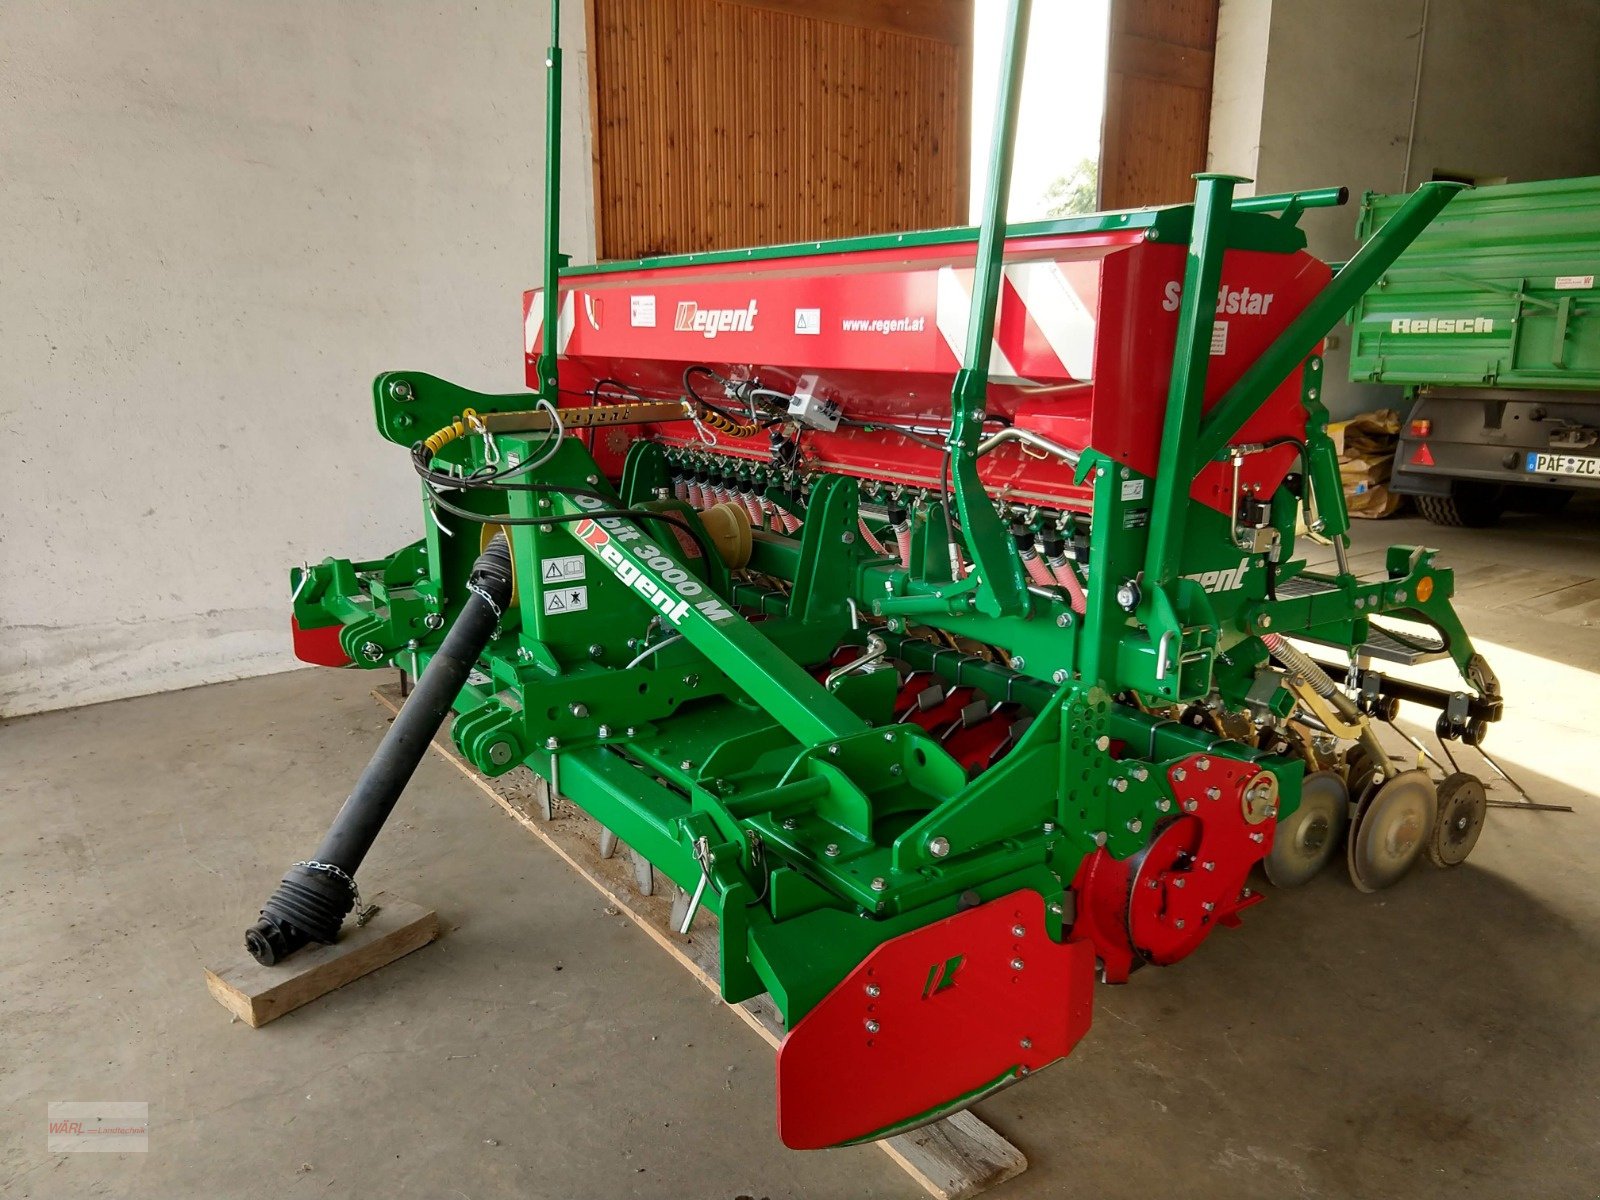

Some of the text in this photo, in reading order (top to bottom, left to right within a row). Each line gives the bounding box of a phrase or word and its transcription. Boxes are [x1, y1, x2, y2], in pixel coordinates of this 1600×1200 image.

[1162, 280, 1274, 316] Sdstar
[674, 299, 758, 339] Regent
[842, 316, 925, 335] www.regent.at
[1537, 456, 1596, 475] PAF ZC
[574, 517, 691, 626] Regent
[633, 544, 703, 597] 3000
[694, 599, 734, 622] M
